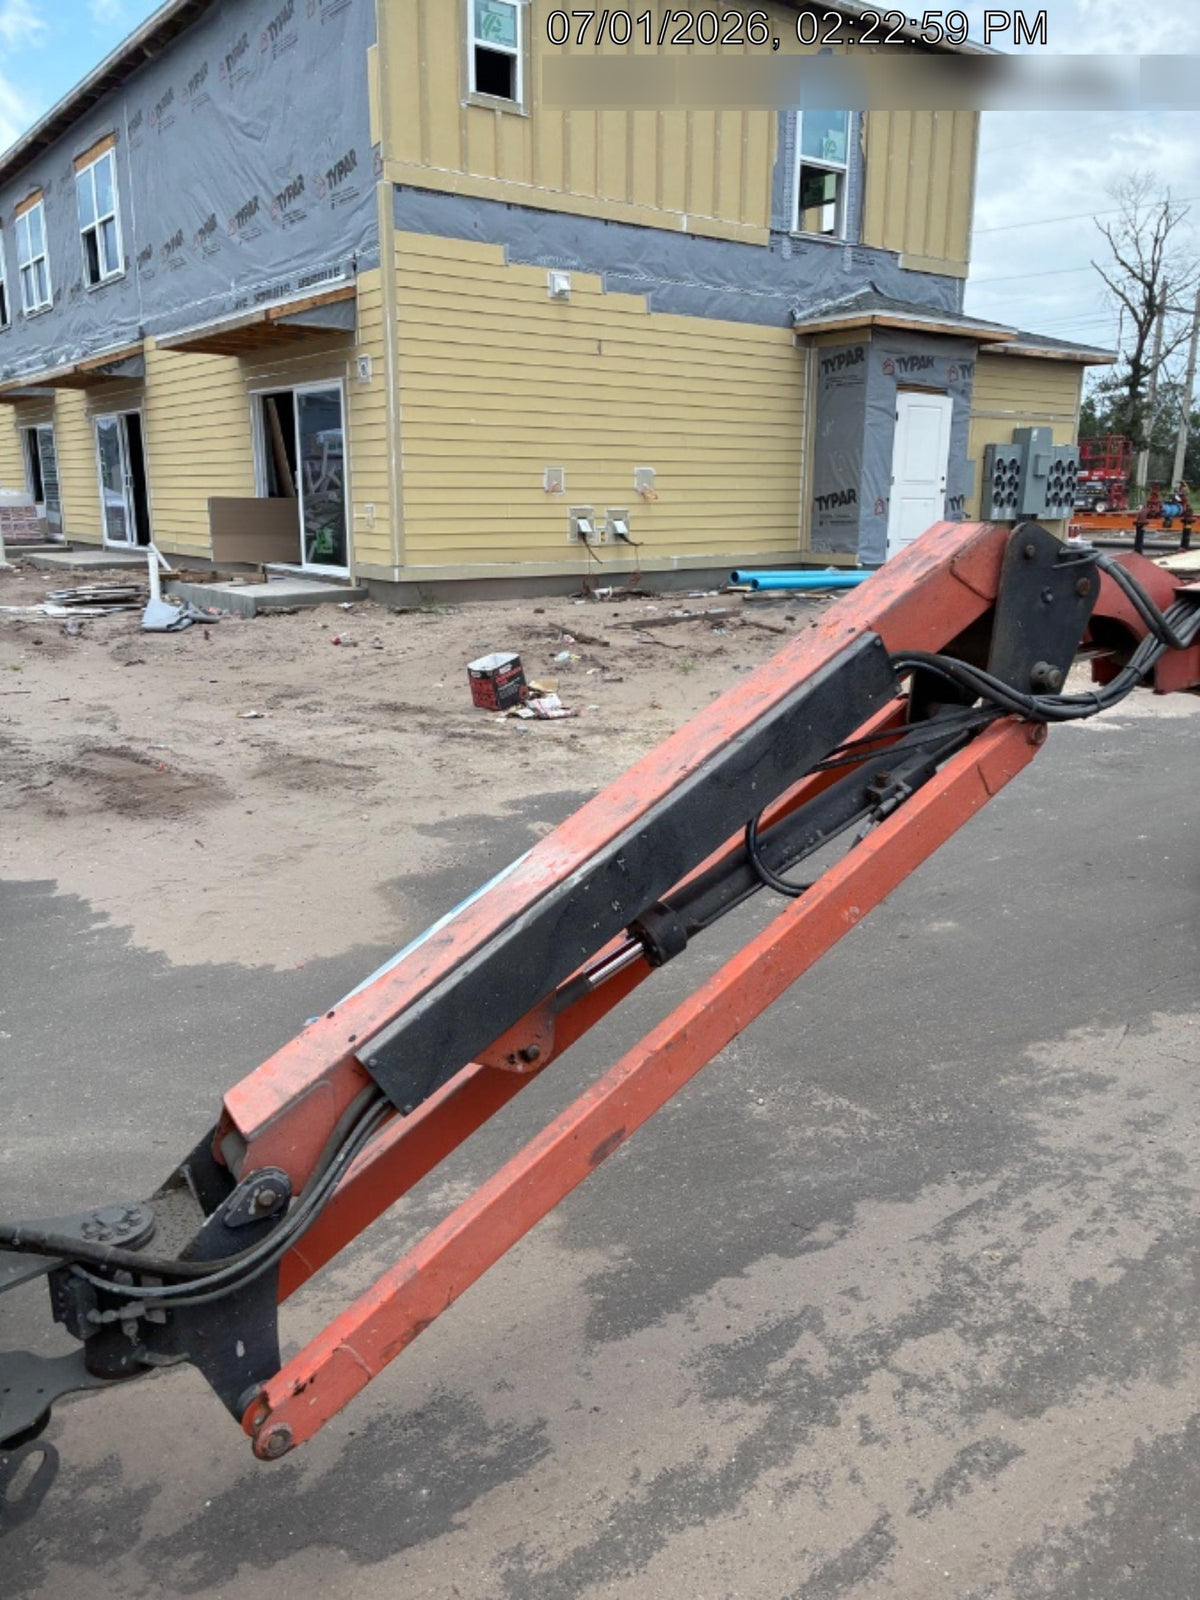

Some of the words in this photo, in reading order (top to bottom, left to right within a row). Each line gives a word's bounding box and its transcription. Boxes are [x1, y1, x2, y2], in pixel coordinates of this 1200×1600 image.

[325, 148, 358, 190] TYPAR
[821, 346, 865, 374] TYPAR
[896, 355, 935, 372] TYPAR
[814, 488, 857, 511] TYPAR
